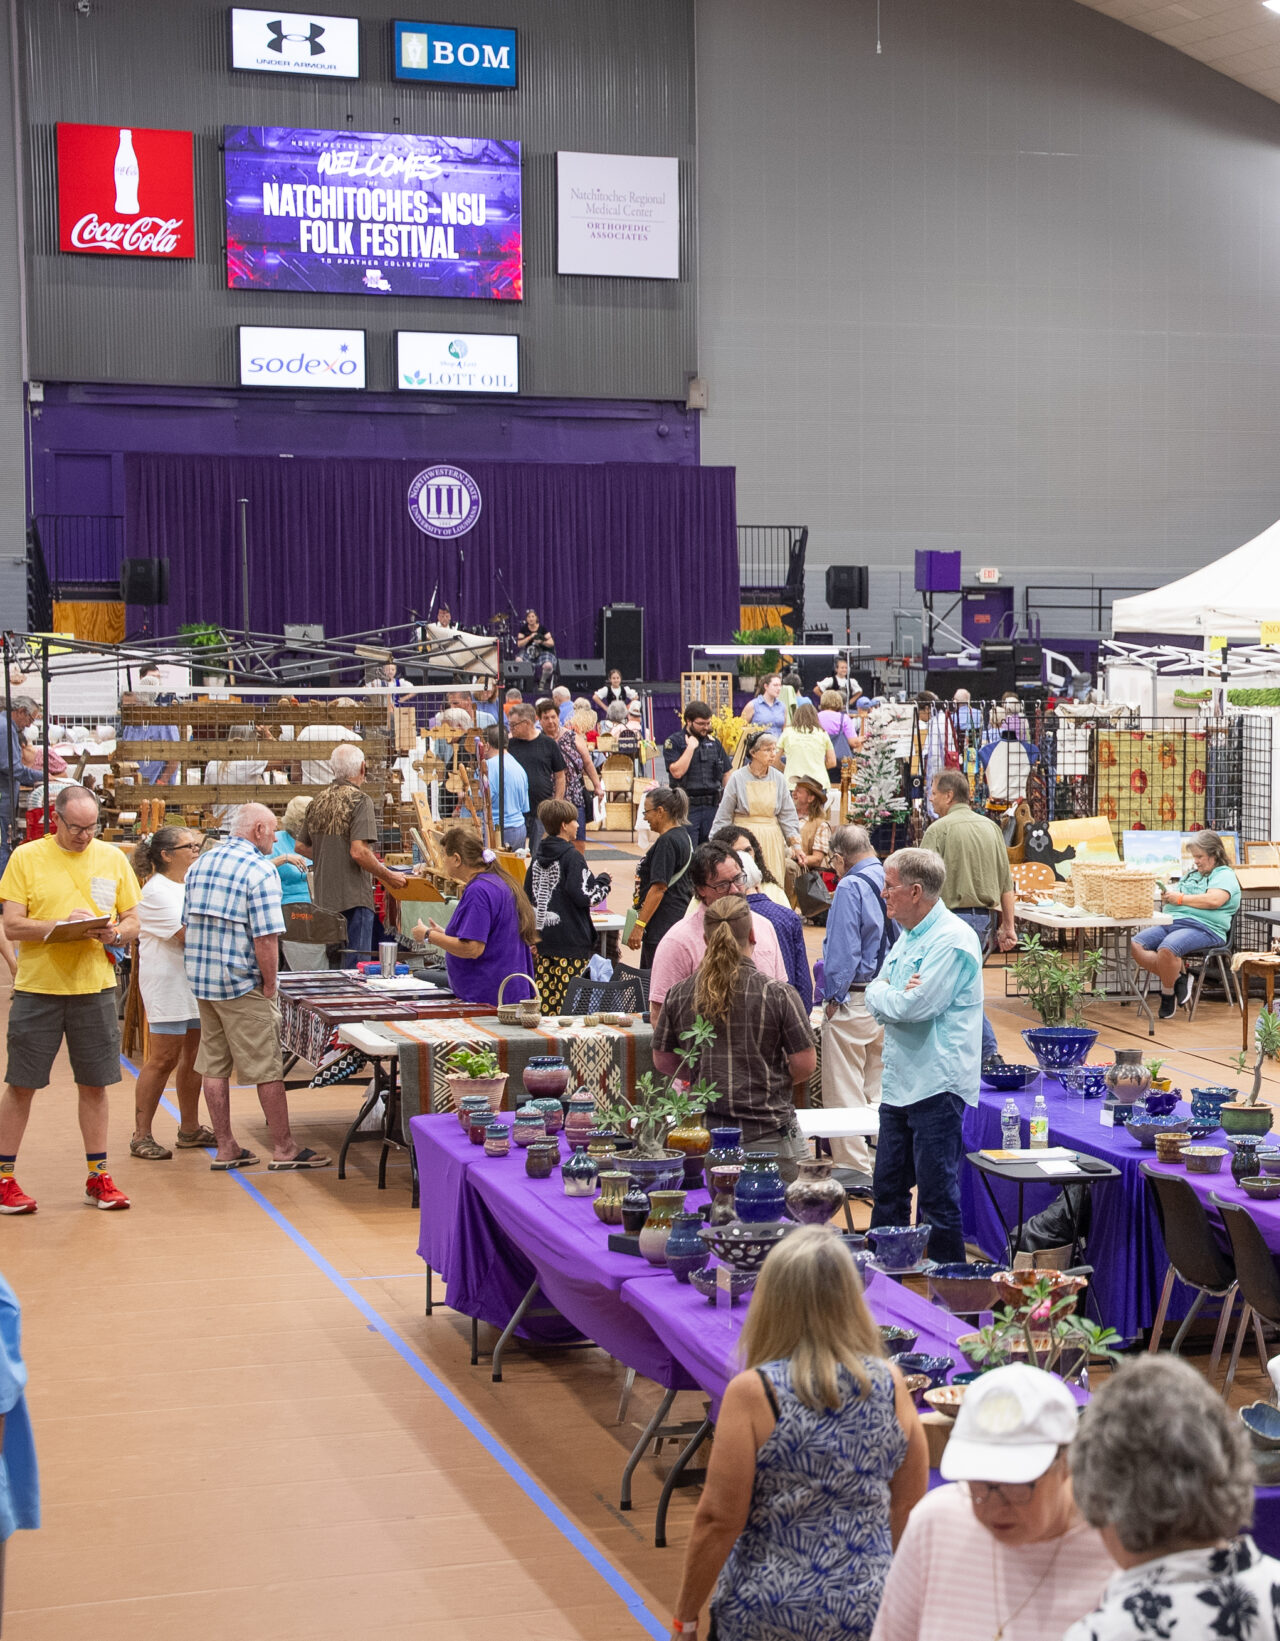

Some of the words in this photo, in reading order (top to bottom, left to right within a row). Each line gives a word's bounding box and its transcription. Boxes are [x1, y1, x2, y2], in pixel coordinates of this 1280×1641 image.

[256, 58, 291, 67] UNDER
[293, 62, 337, 70] ARMOUR
[433, 41, 510, 69] BOM
[317, 149, 443, 184] WELCOMES
[263, 182, 486, 226] NATCHITOCHES-NSU
[570, 187, 626, 202] Natchitoches
[629, 191, 666, 207] Regional
[586, 203, 620, 215] Medical
[623, 204, 653, 217] Center
[71, 213, 183, 253] Coca-Cola
[587, 222, 651, 233] ORTHOPEDIC
[590, 231, 648, 241] ASSOCIATES
[300, 220, 354, 255] FOLK
[360, 222, 460, 259] FESTIVAL
[337, 258, 379, 266] PRATHER
[384, 260, 430, 268] COLISEUM
[248, 353, 357, 375] sodexo
[429, 372, 476, 386] LOTT
[481, 374, 513, 387] OIL
[410, 468, 465, 499] NORTHWESTERN
[463, 478, 478, 501] STATE
[410, 504, 441, 535] UNIVERSITY
[452, 505, 478, 533] LOUISIANA
[983, 569, 996, 579] EXIT
